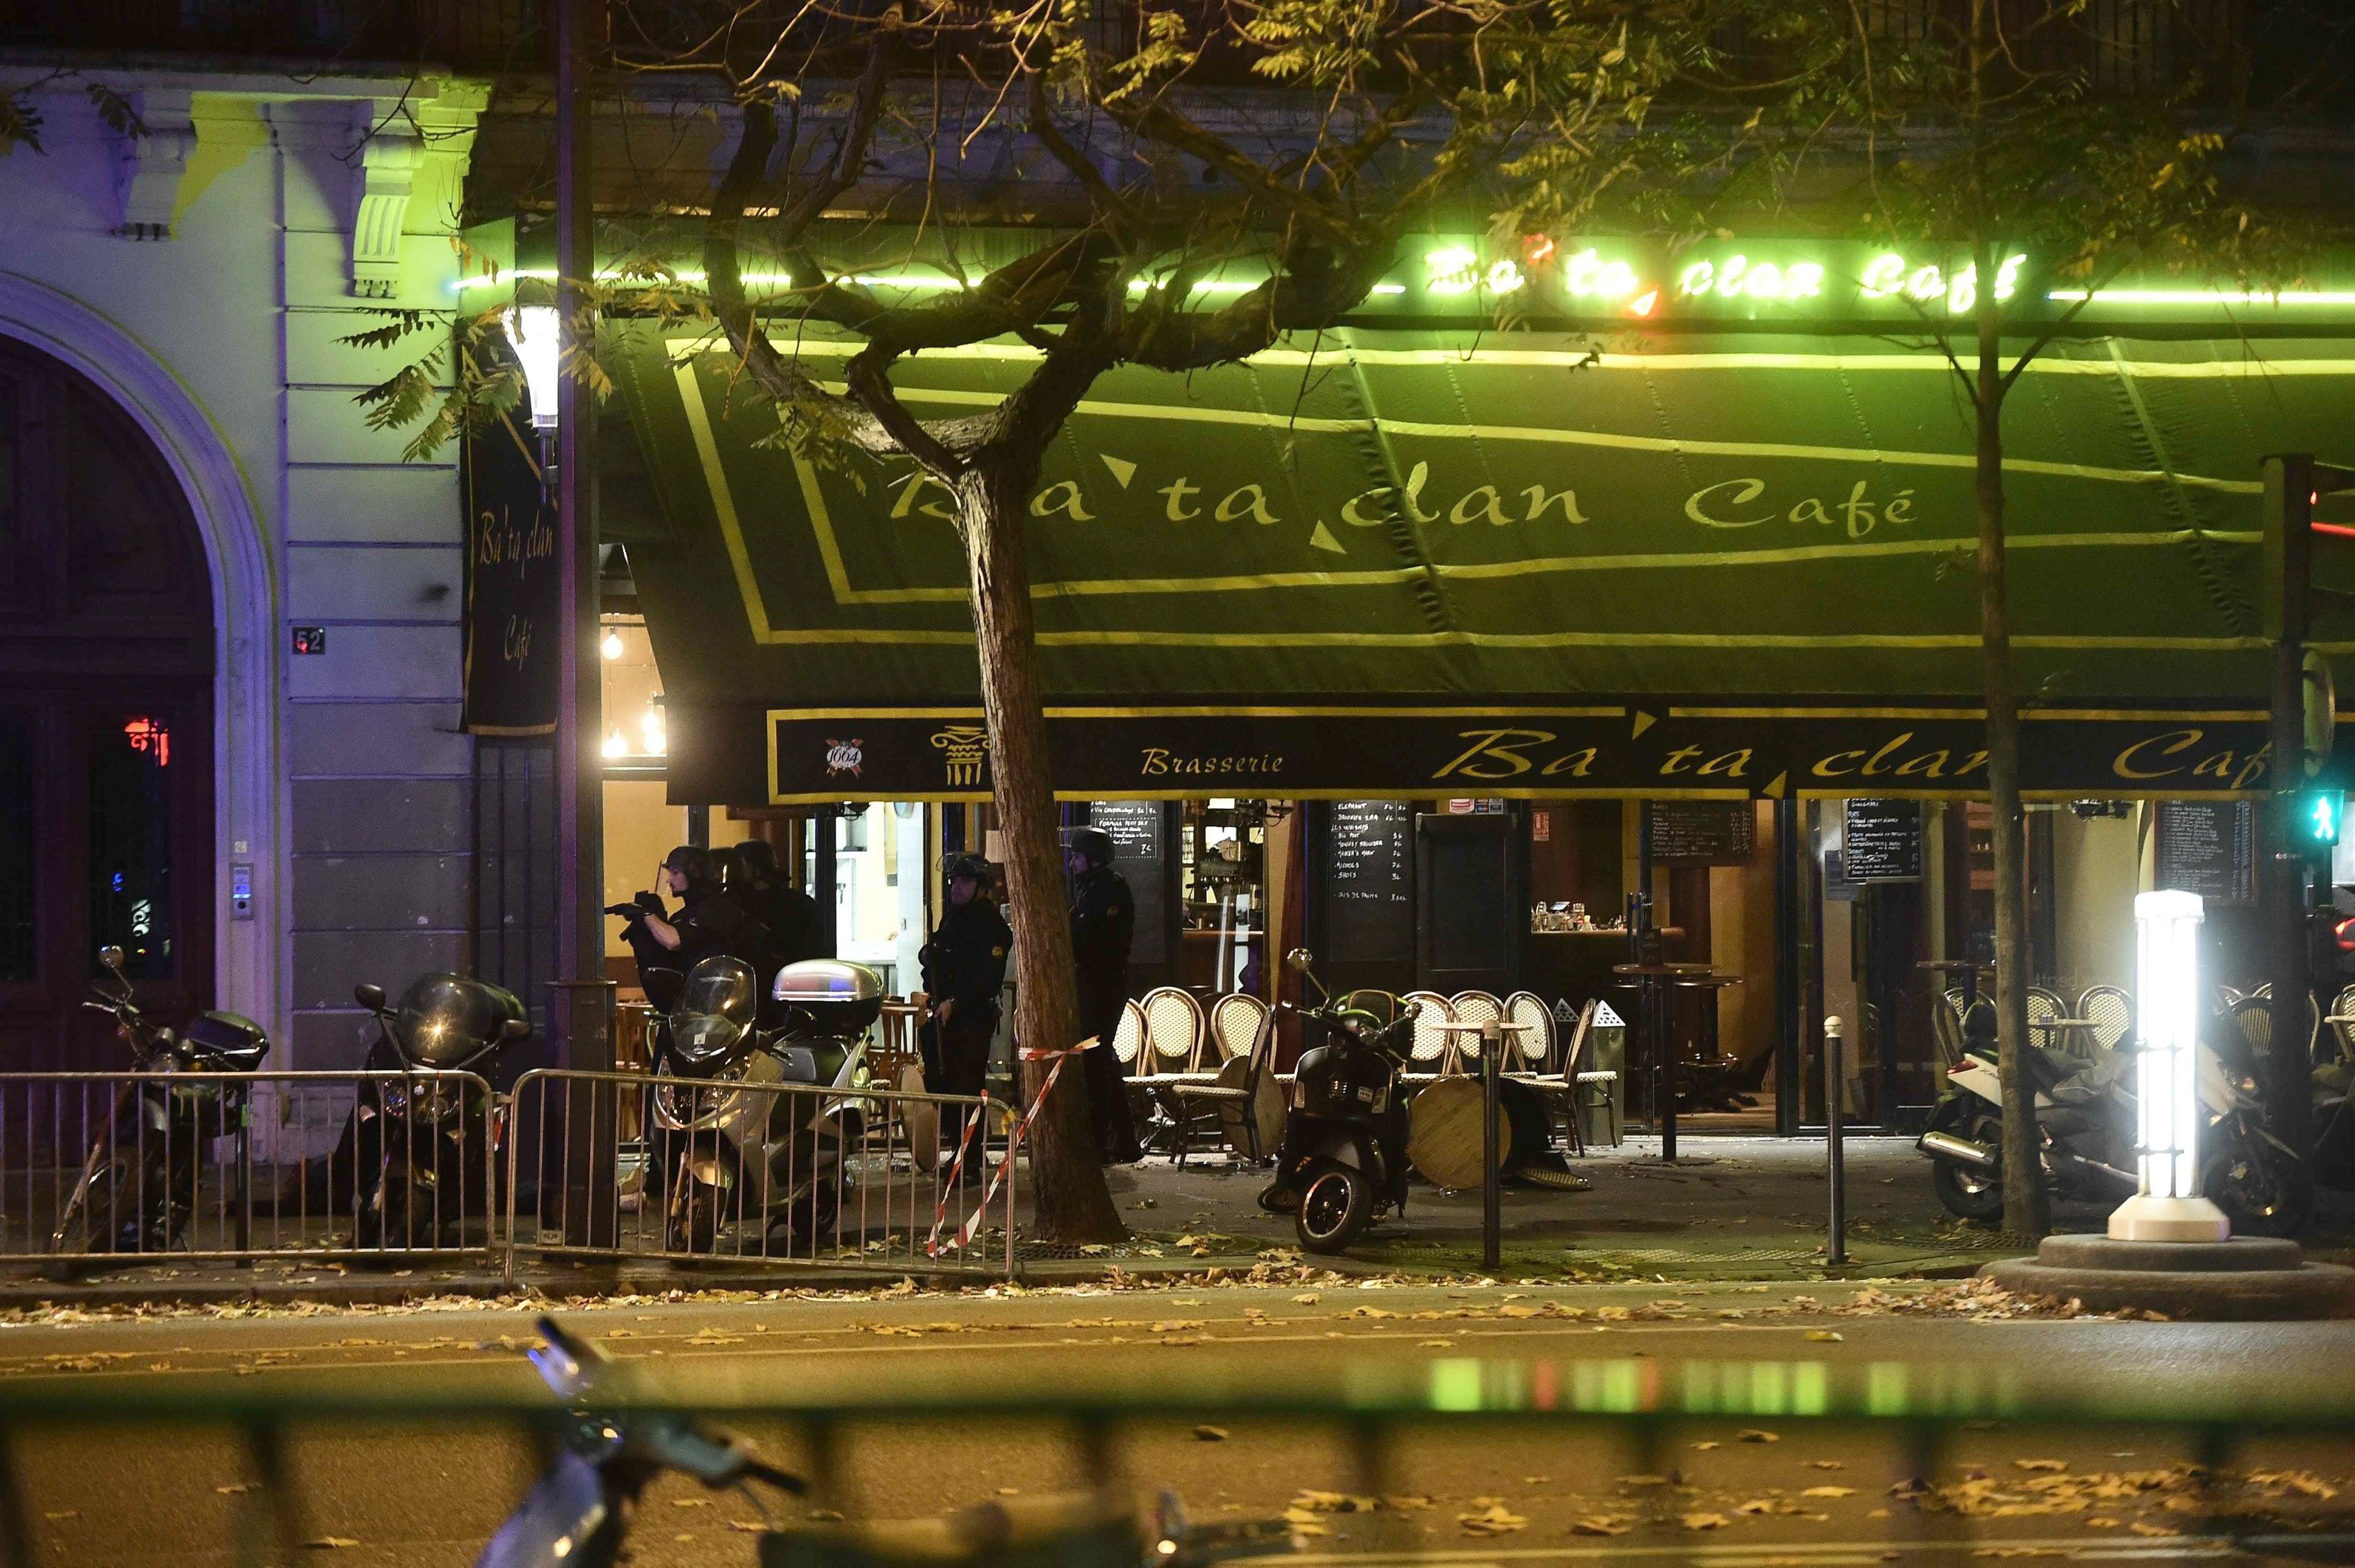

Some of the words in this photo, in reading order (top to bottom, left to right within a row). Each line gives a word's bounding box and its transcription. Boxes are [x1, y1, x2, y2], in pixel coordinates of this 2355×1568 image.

[1685, 478, 1917, 537] Café
[505, 614, 532, 672] Café
[827, 747, 860, 763] 1664
[1142, 747, 1283, 775] Brasserie
[2111, 730, 2272, 789] Caf
